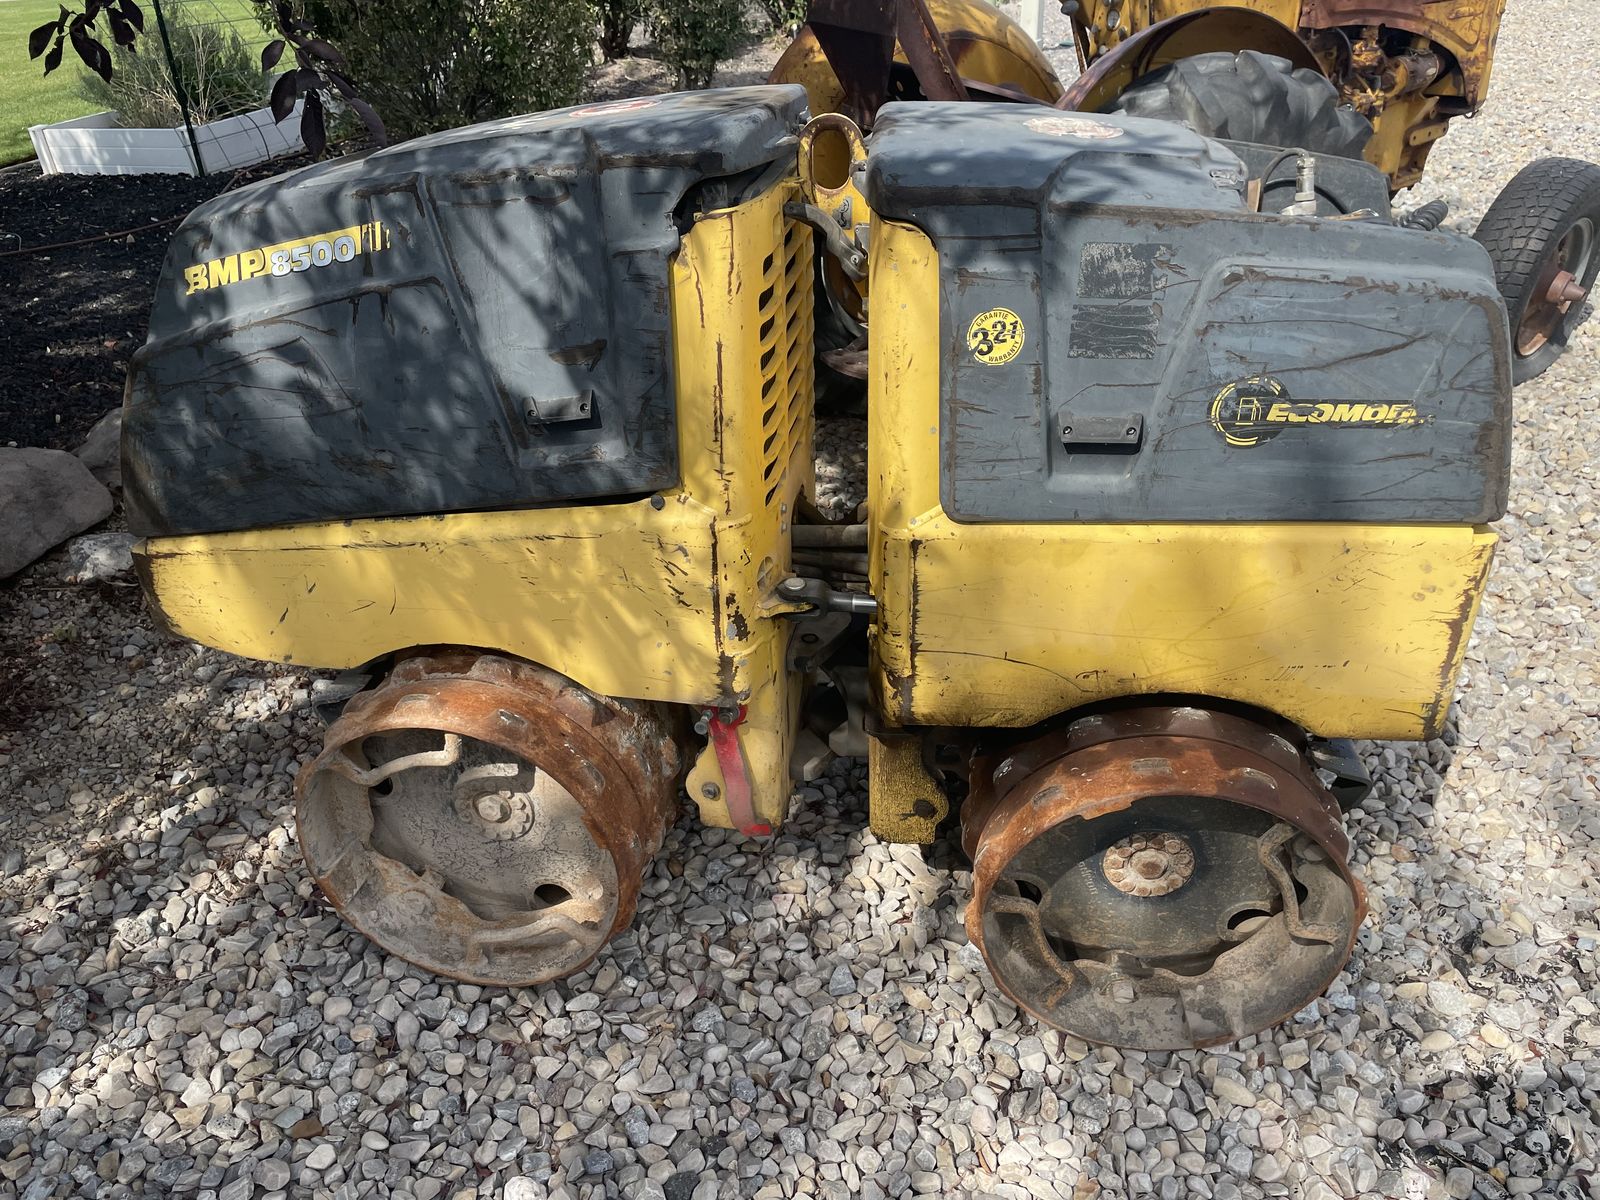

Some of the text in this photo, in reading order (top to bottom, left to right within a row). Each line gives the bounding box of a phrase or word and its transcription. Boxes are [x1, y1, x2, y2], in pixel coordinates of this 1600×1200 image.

[184, 235, 356, 296] BMP 8500
[975, 311, 1009, 328] GARANTIE
[988, 340, 1020, 362] WARRANTY
